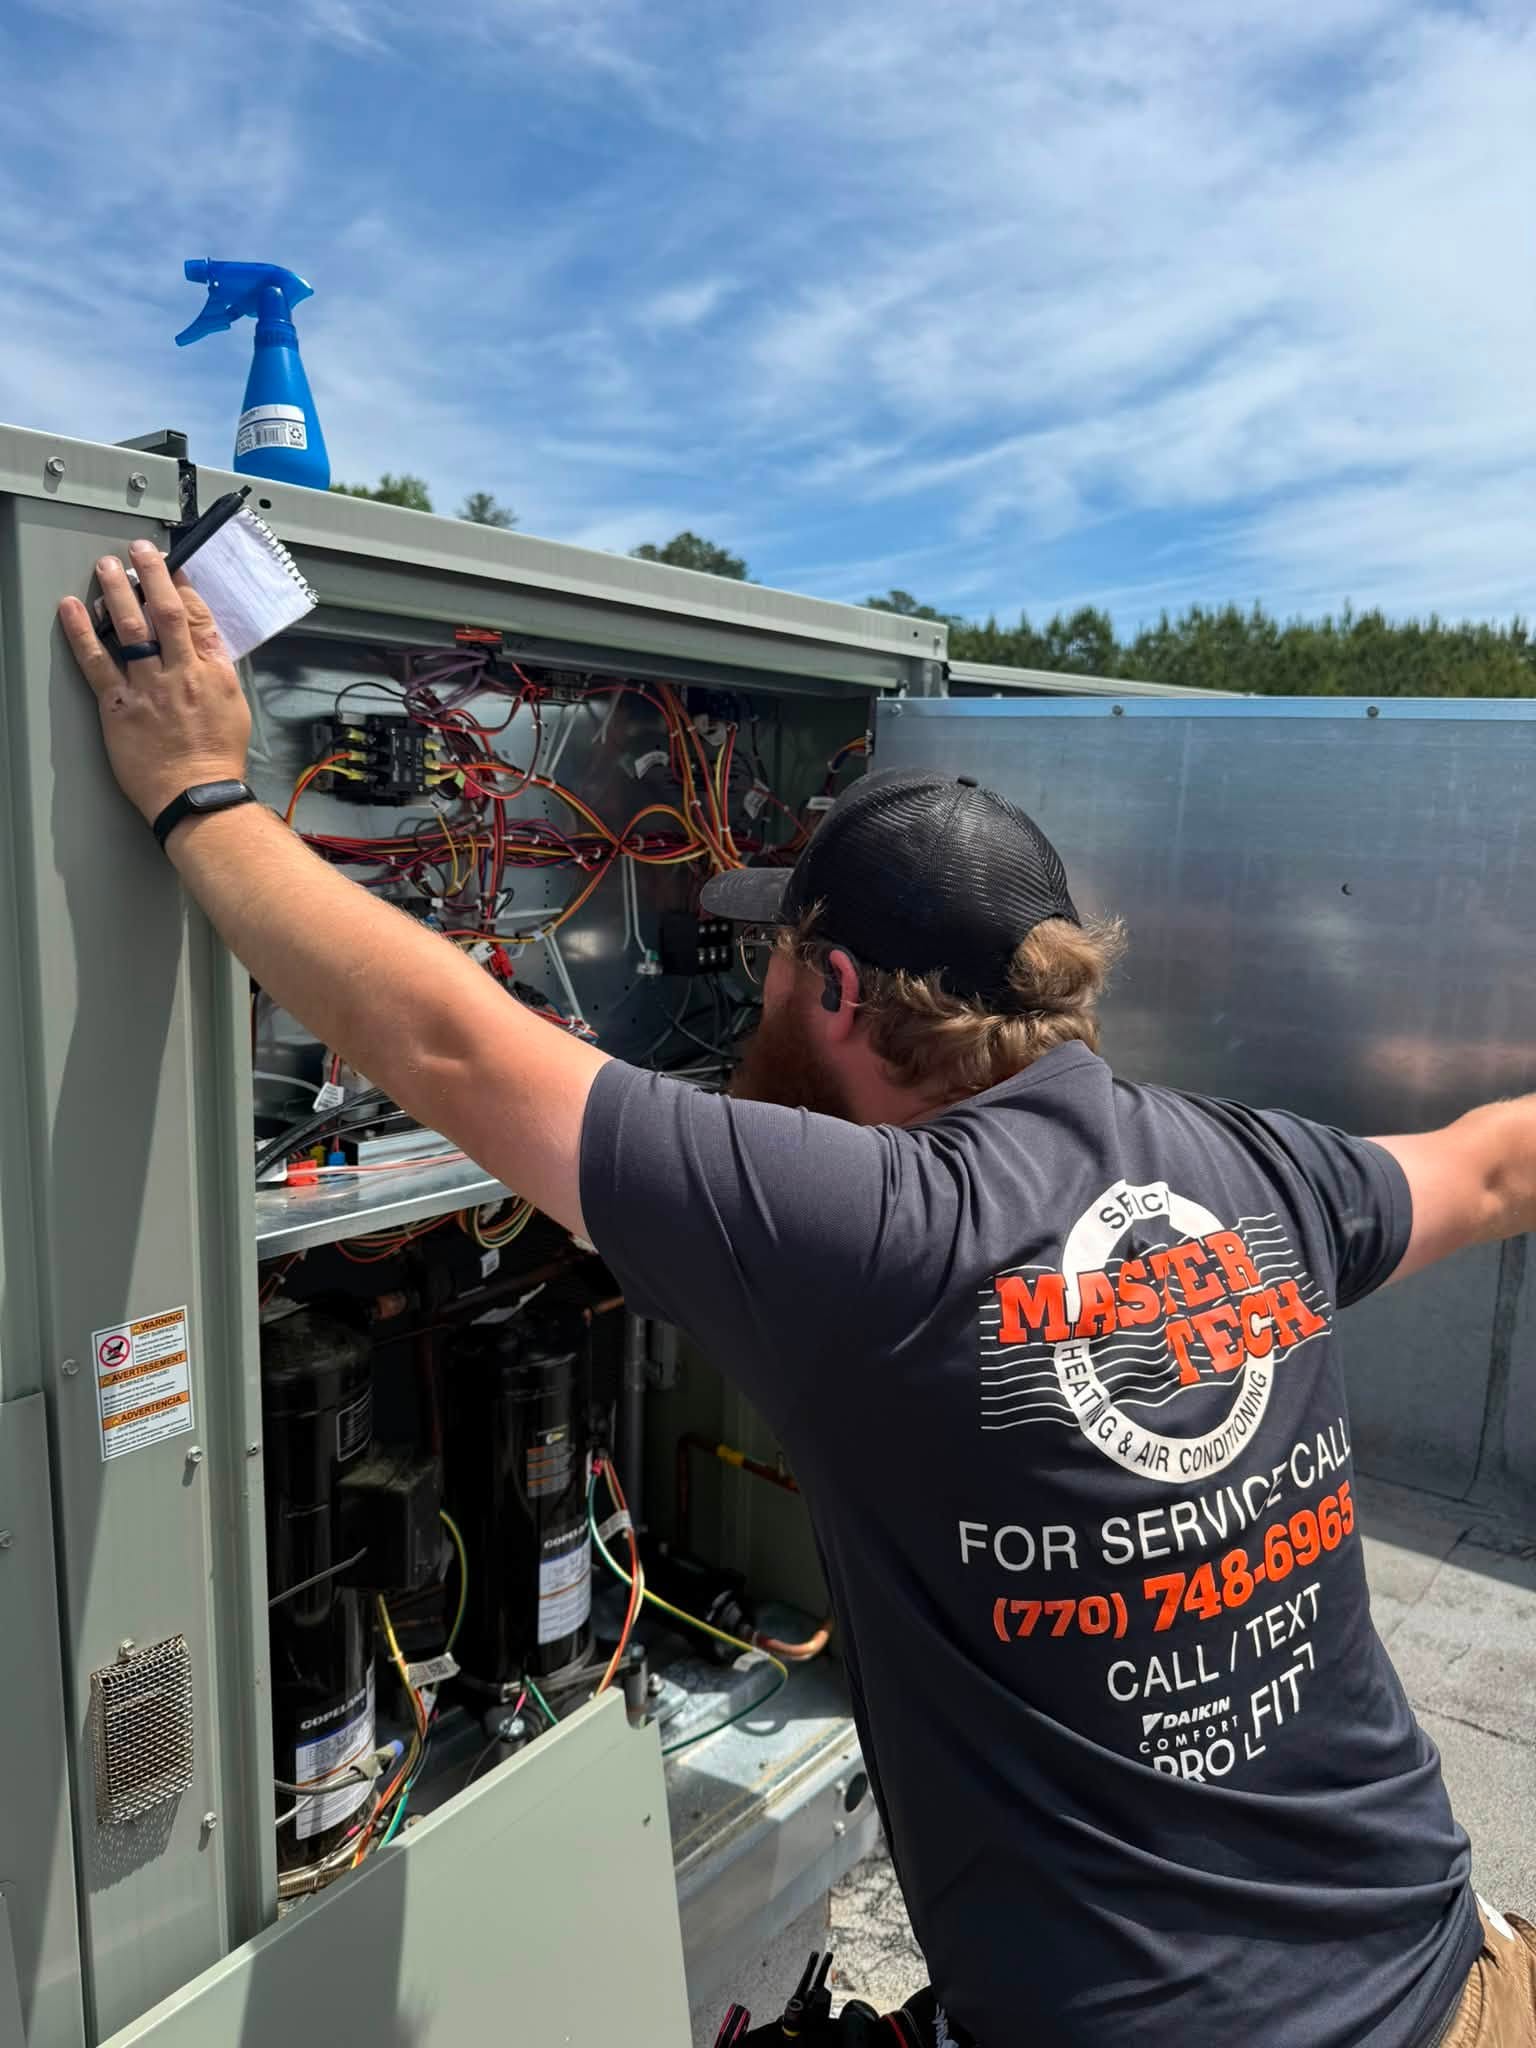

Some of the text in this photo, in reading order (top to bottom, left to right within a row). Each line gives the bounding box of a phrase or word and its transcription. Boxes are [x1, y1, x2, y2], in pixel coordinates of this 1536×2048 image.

[140, 1312, 183, 1331] WARNING
[996, 1230, 1264, 1344] MASTER
[111, 1353, 183, 1382] AVERTISSEMENT
[1165, 1279, 1328, 1387] TECH
[121, 1396, 182, 1422] ADVERTENCIA
[1061, 1345, 1267, 1474] HEATING & AIR CONDITIONING
[958, 1520, 1079, 1572] FOR
[1101, 1461, 1287, 1566] SERVICE
[993, 1480, 1355, 1642] (770) 748-6965
[1107, 1582, 1321, 1702] CALL / TEXT
[1139, 1714, 1238, 1754] COMFORT
[1163, 1696, 1230, 1729] DAIKIN
[1250, 1663, 1304, 1739] FIT
[1153, 1738, 1236, 1783] PRO
